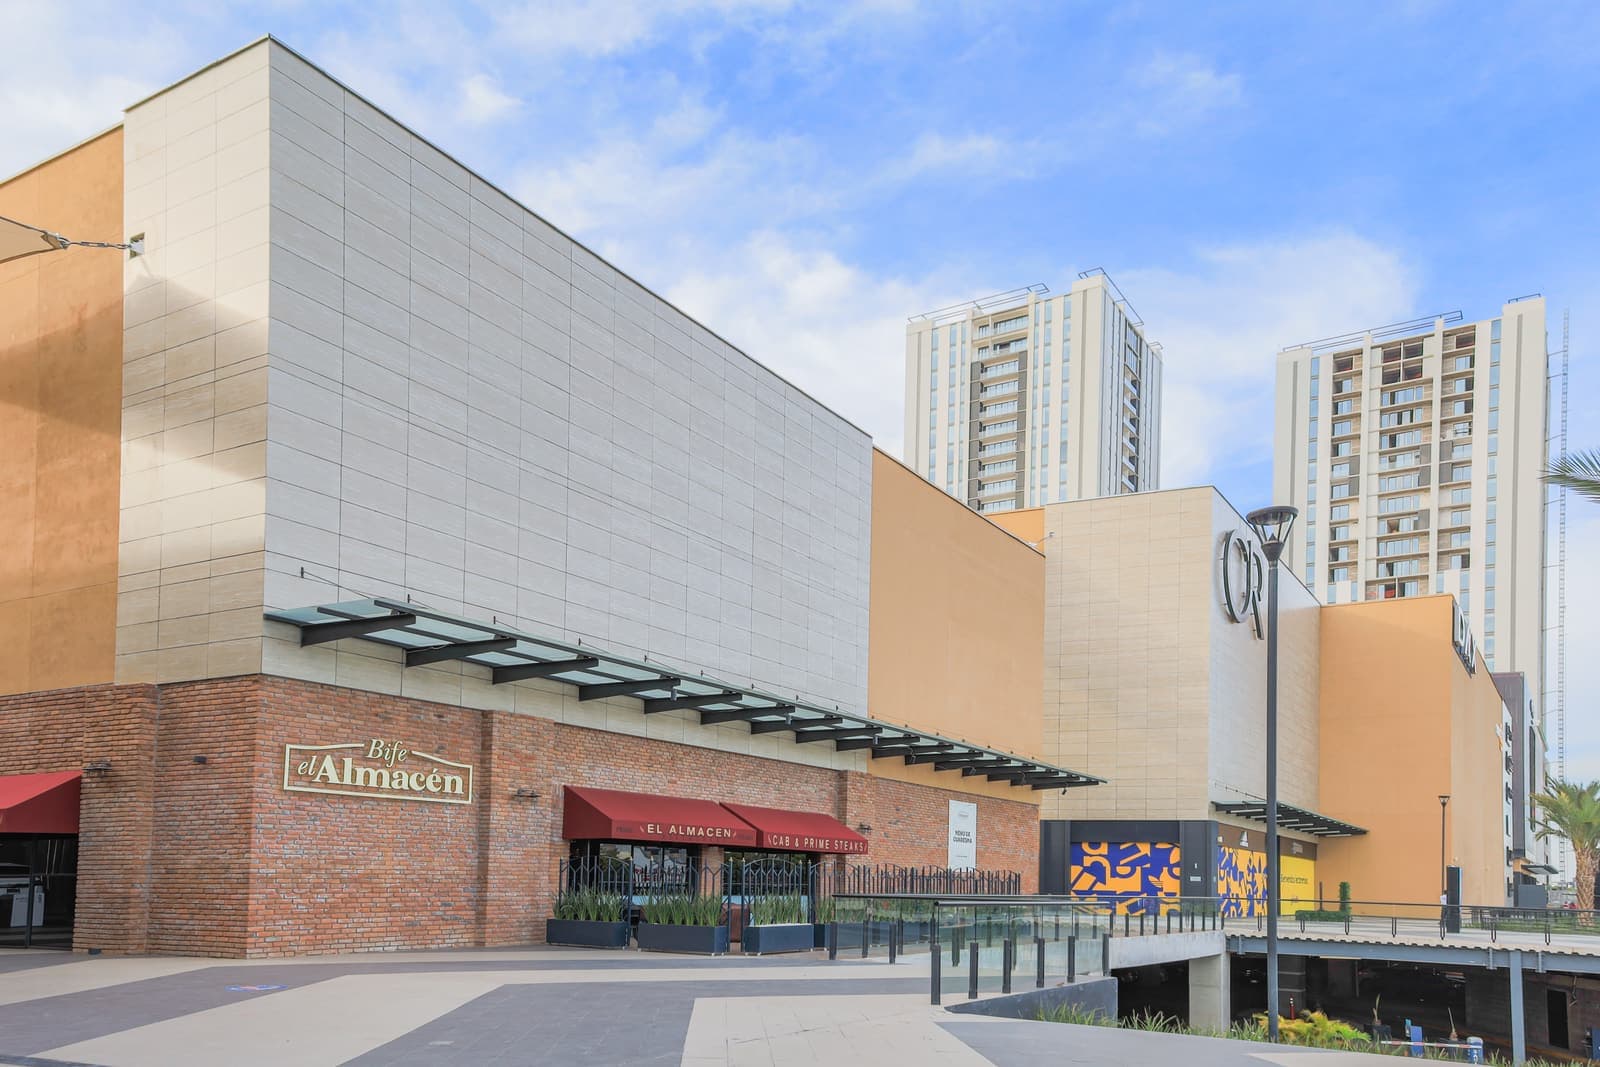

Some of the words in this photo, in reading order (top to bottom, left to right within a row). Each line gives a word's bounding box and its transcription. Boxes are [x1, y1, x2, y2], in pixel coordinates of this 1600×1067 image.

[365, 738, 408, 768] Bife
[297, 755, 317, 776] el
[312, 754, 464, 795] Almacén
[647, 823, 662, 834] EL
[669, 824, 731, 838] ALMACEN
[772, 835, 790, 847] CAB
[794, 837, 799, 848] &
[804, 836, 830, 850] PRIME
[834, 839, 864, 853] STEAKS
